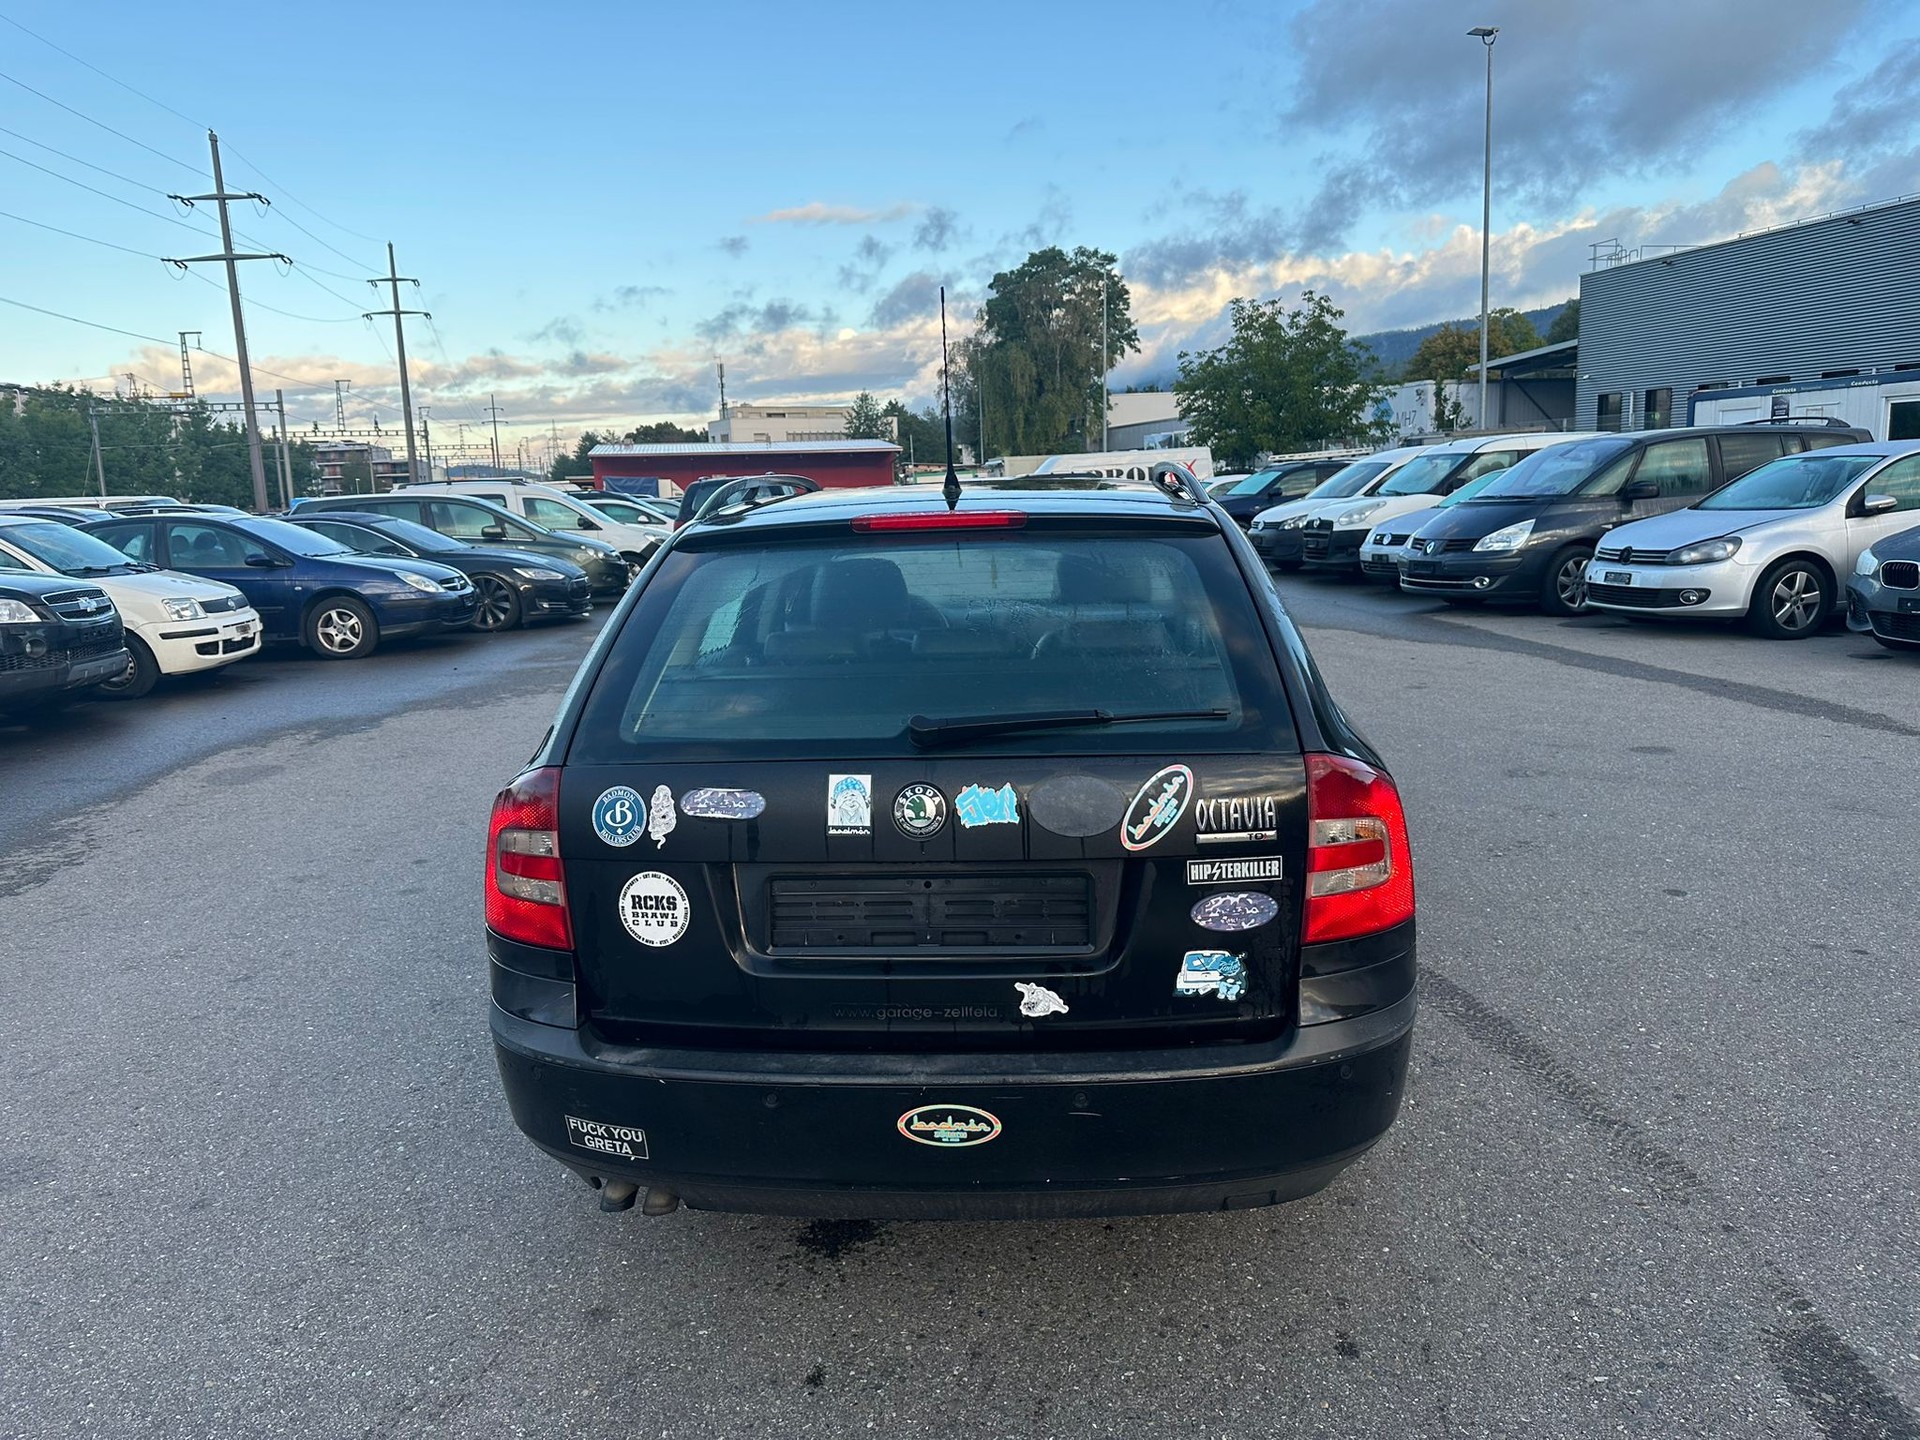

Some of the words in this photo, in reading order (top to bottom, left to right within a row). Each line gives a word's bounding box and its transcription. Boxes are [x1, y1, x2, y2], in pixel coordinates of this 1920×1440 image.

[1195, 796, 1277, 831] OCTAVIA
[1190, 860, 1280, 881] HIPSTERKILLER
[630, 894, 678, 912] RCKS
[631, 911, 678, 920] BRAWL
[632, 919, 678, 928] CLUB
[569, 1118, 608, 1138] FUCK
[610, 1127, 643, 1142] YOU
[584, 1135, 633, 1155] GRETA
